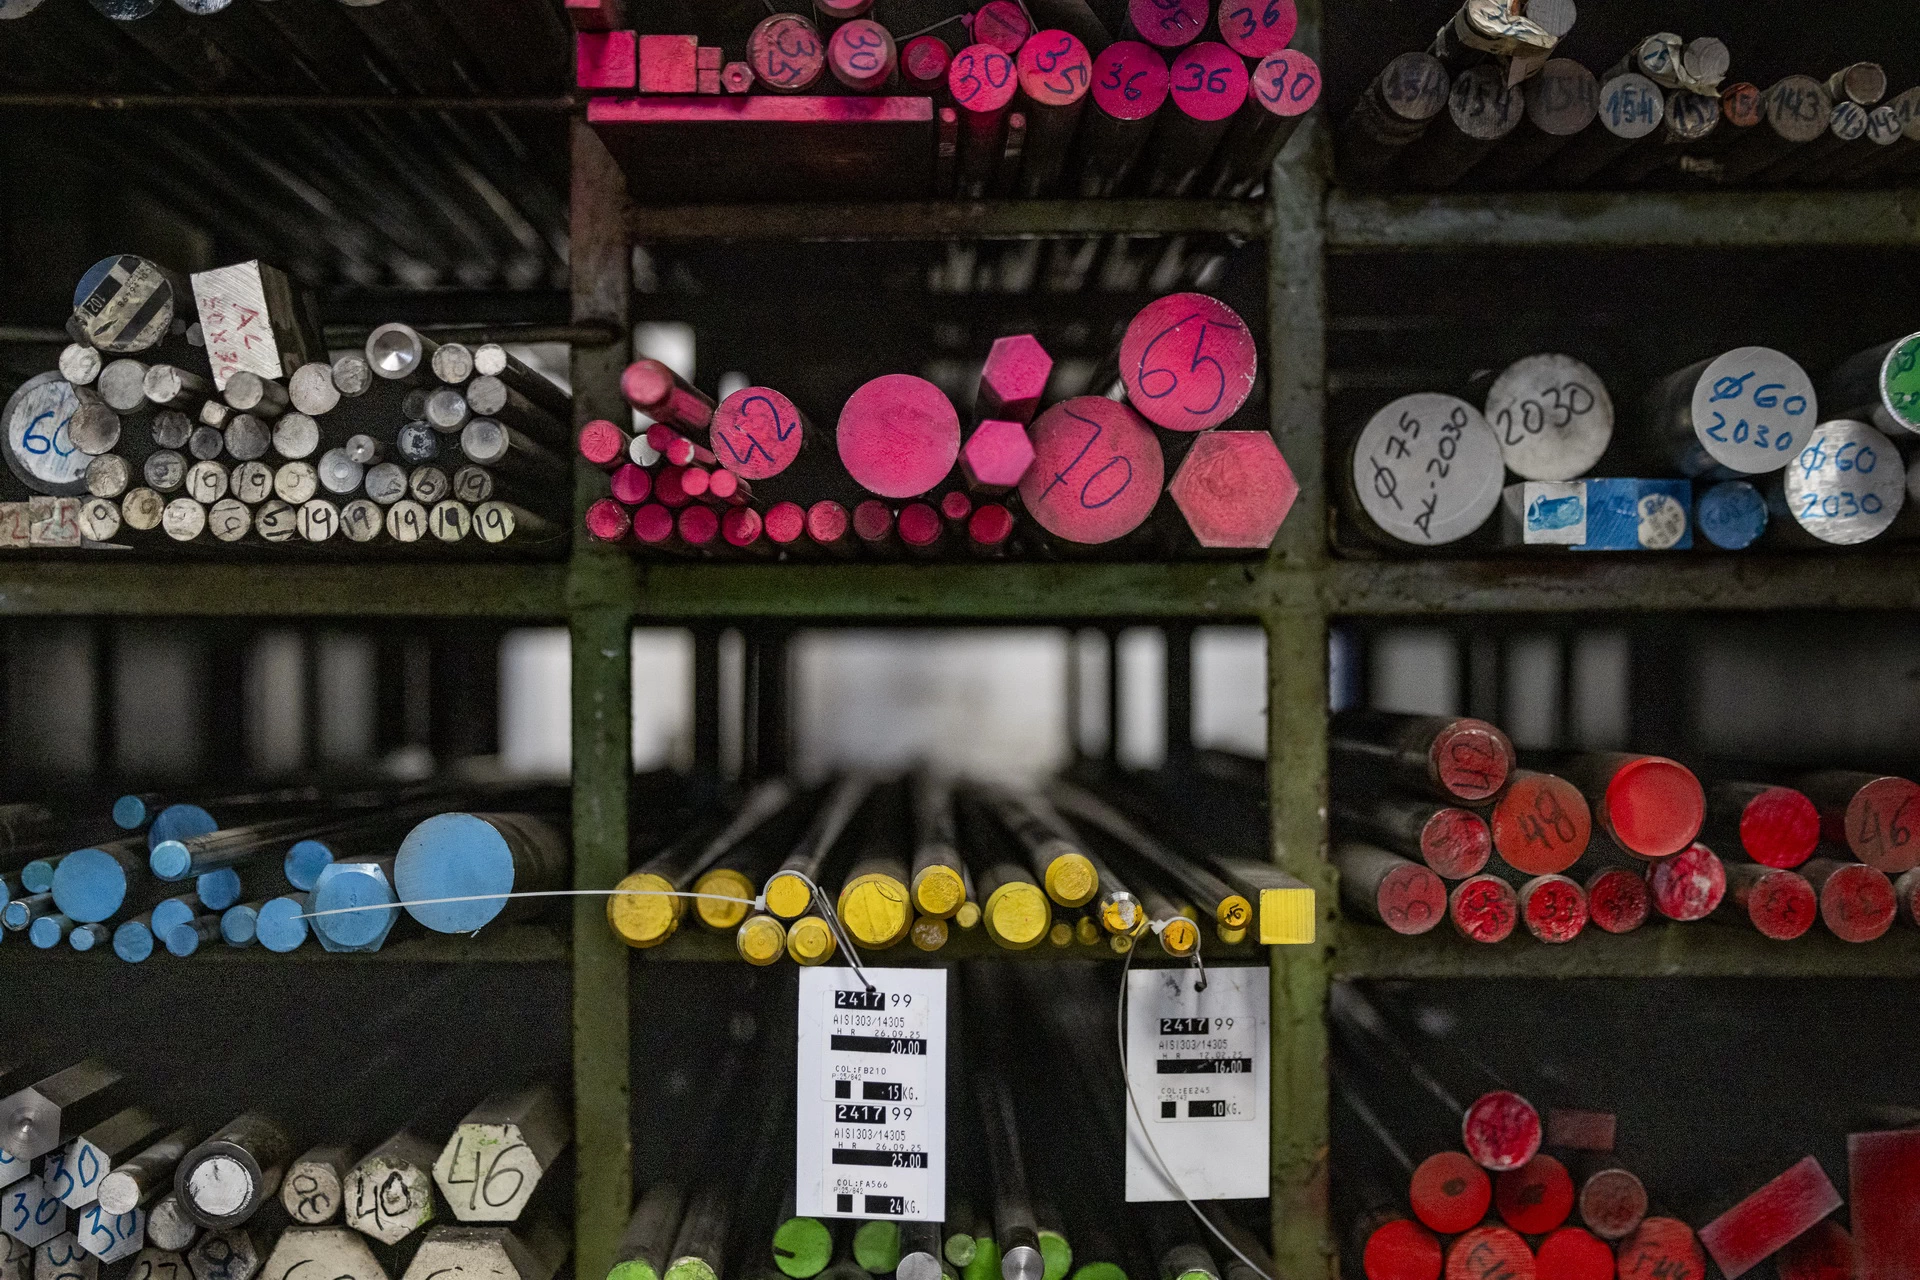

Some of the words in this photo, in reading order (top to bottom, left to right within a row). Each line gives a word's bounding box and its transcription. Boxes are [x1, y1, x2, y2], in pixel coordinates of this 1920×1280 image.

[1229, 0, 1281, 39] 36
[843, 27, 882, 71] 30
[957, 54, 1013, 103] 30
[1100, 62, 1148, 101] 36
[1175, 62, 1232, 94] 36
[1259, 59, 1315, 102] 30
[86, 291, 108, 314] 102
[1138, 313, 1242, 414] 65
[717, 395, 796, 464] 42
[1496, 382, 1594, 446] 2030
[1705, 411, 1794, 451] 2030
[1038, 408, 1133, 509] 70
[193, 468, 218, 500] 19
[238, 462, 266, 498] 19
[438, 506, 463, 539] 19
[1800, 492, 1882, 520] 2030
[394, 508, 420, 540] 19
[475, 508, 507, 541] 19
[1859, 796, 1912, 858] 46
[837, 991, 883, 1008] 2417
[891, 993, 912, 1008] 99
[833, 1014, 905, 1028] AISI303/14305
[1163, 1018, 1207, 1032] 2417
[1214, 1018, 1234, 1031] 99
[890, 1040, 919, 1055] 20,00
[1159, 1039, 1228, 1050] AISI303/14305
[1214, 1061, 1243, 1073] 16,00
[888, 1085, 899, 1100] 15
[1212, 1102, 1224, 1116] 10
[838, 1105, 883, 1120] 2417
[892, 1107, 913, 1121] 99
[834, 1128, 906, 1141] AISI303/14305
[51, 1144, 99, 1200] 30
[448, 1137, 528, 1211] 46
[892, 1153, 921, 1168] 25,00
[13, 1193, 60, 1232] 30
[356, 1170, 412, 1231] 40
[890, 1198, 901, 1213] 24
[85, 1204, 136, 1255] 30
